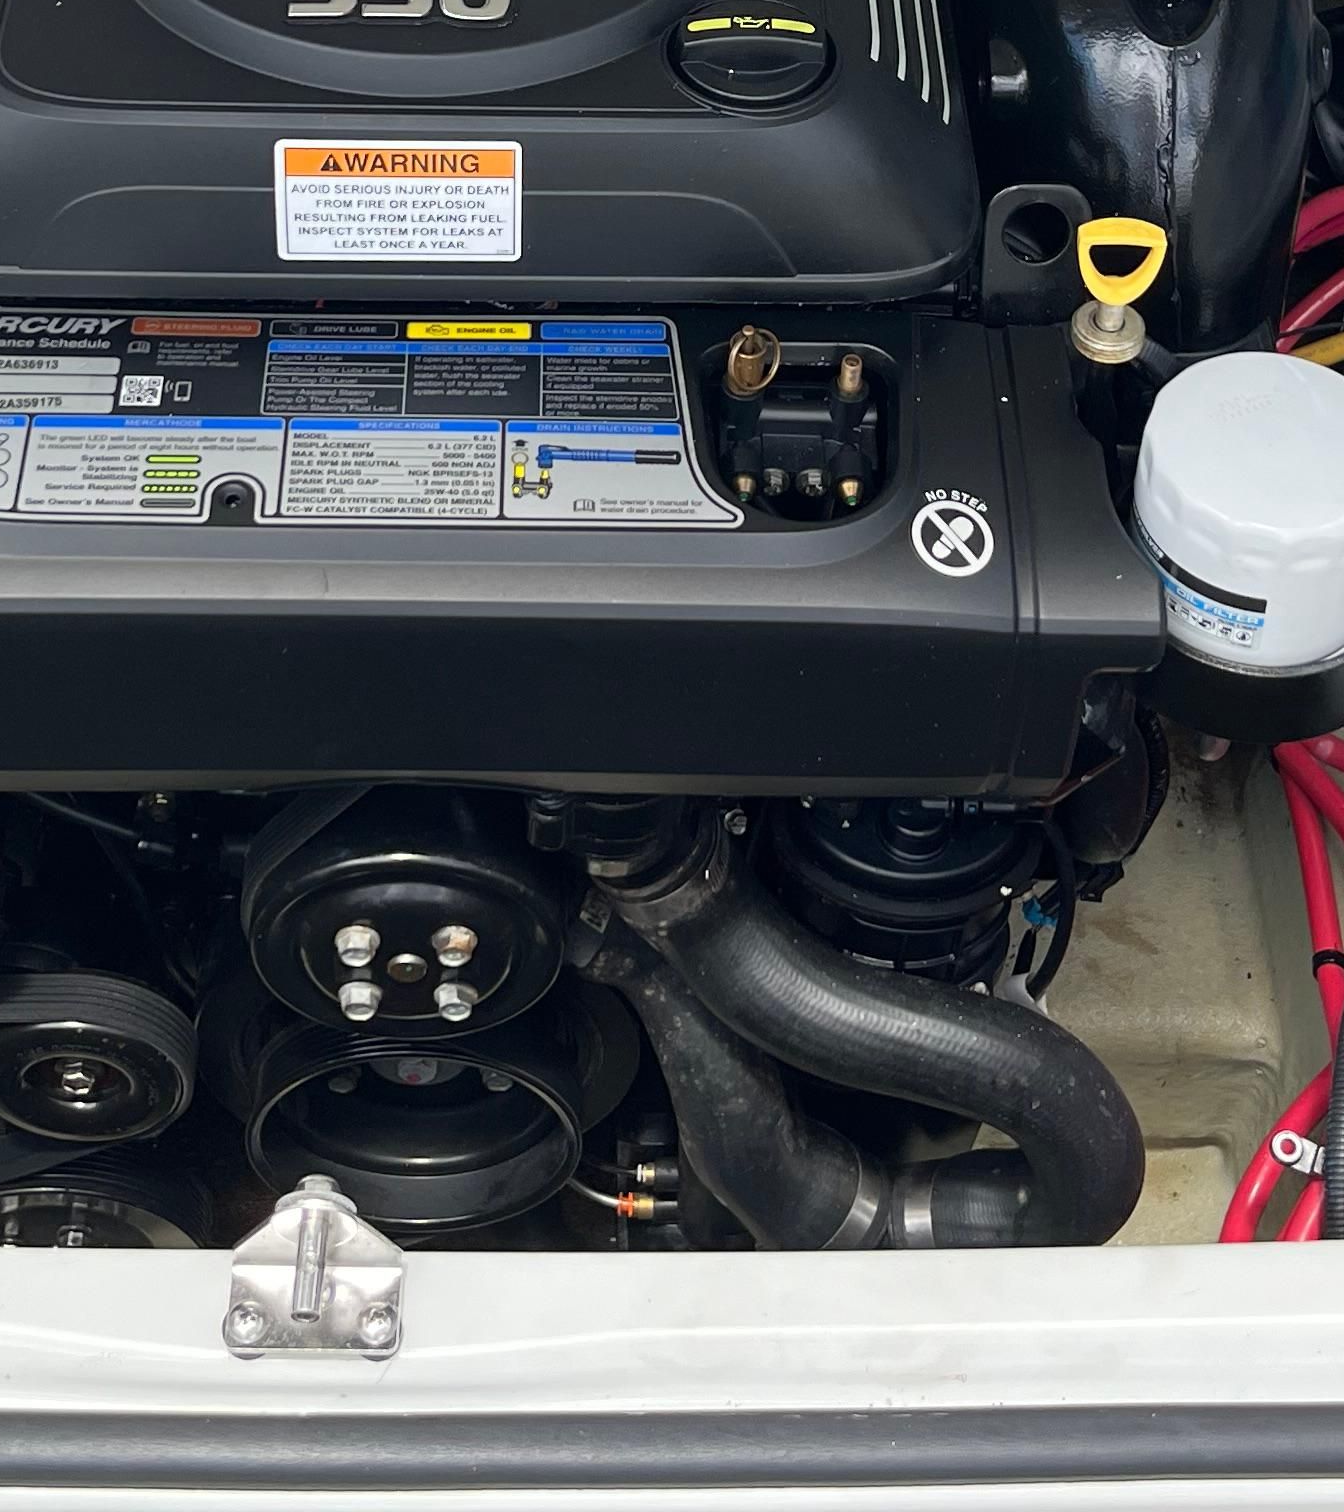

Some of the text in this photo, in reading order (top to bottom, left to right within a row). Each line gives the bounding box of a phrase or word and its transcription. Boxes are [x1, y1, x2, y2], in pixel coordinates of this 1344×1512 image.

[344, 153, 479, 172] WARNING
[291, 184, 508, 195] AVOID SERIOUS INJURY OR DEATH
[316, 199, 484, 209] FROM FIRE OR EXPLOSION
[294, 213, 365, 221] RESULTING
[370, 214, 406, 222] FROM
[411, 214, 466, 222] LEAKING
[298, 227, 351, 235] INSPECT
[357, 227, 407, 235] SYSTEM
[442, 228, 483, 236] LEAKS
[487, 228, 503, 236] AT
[334, 240, 374, 248] LEAST
[379, 240, 414, 248] ONCE
[39, 337, 110, 349] Schedule
[81, 454, 140, 463] System OK
[24, 496, 134, 507] See Owner's Manual
[925, 489, 988, 512] NO STEP
[1176, 586, 1199, 606] OIL
[1205, 600, 1260, 625] FILTER
